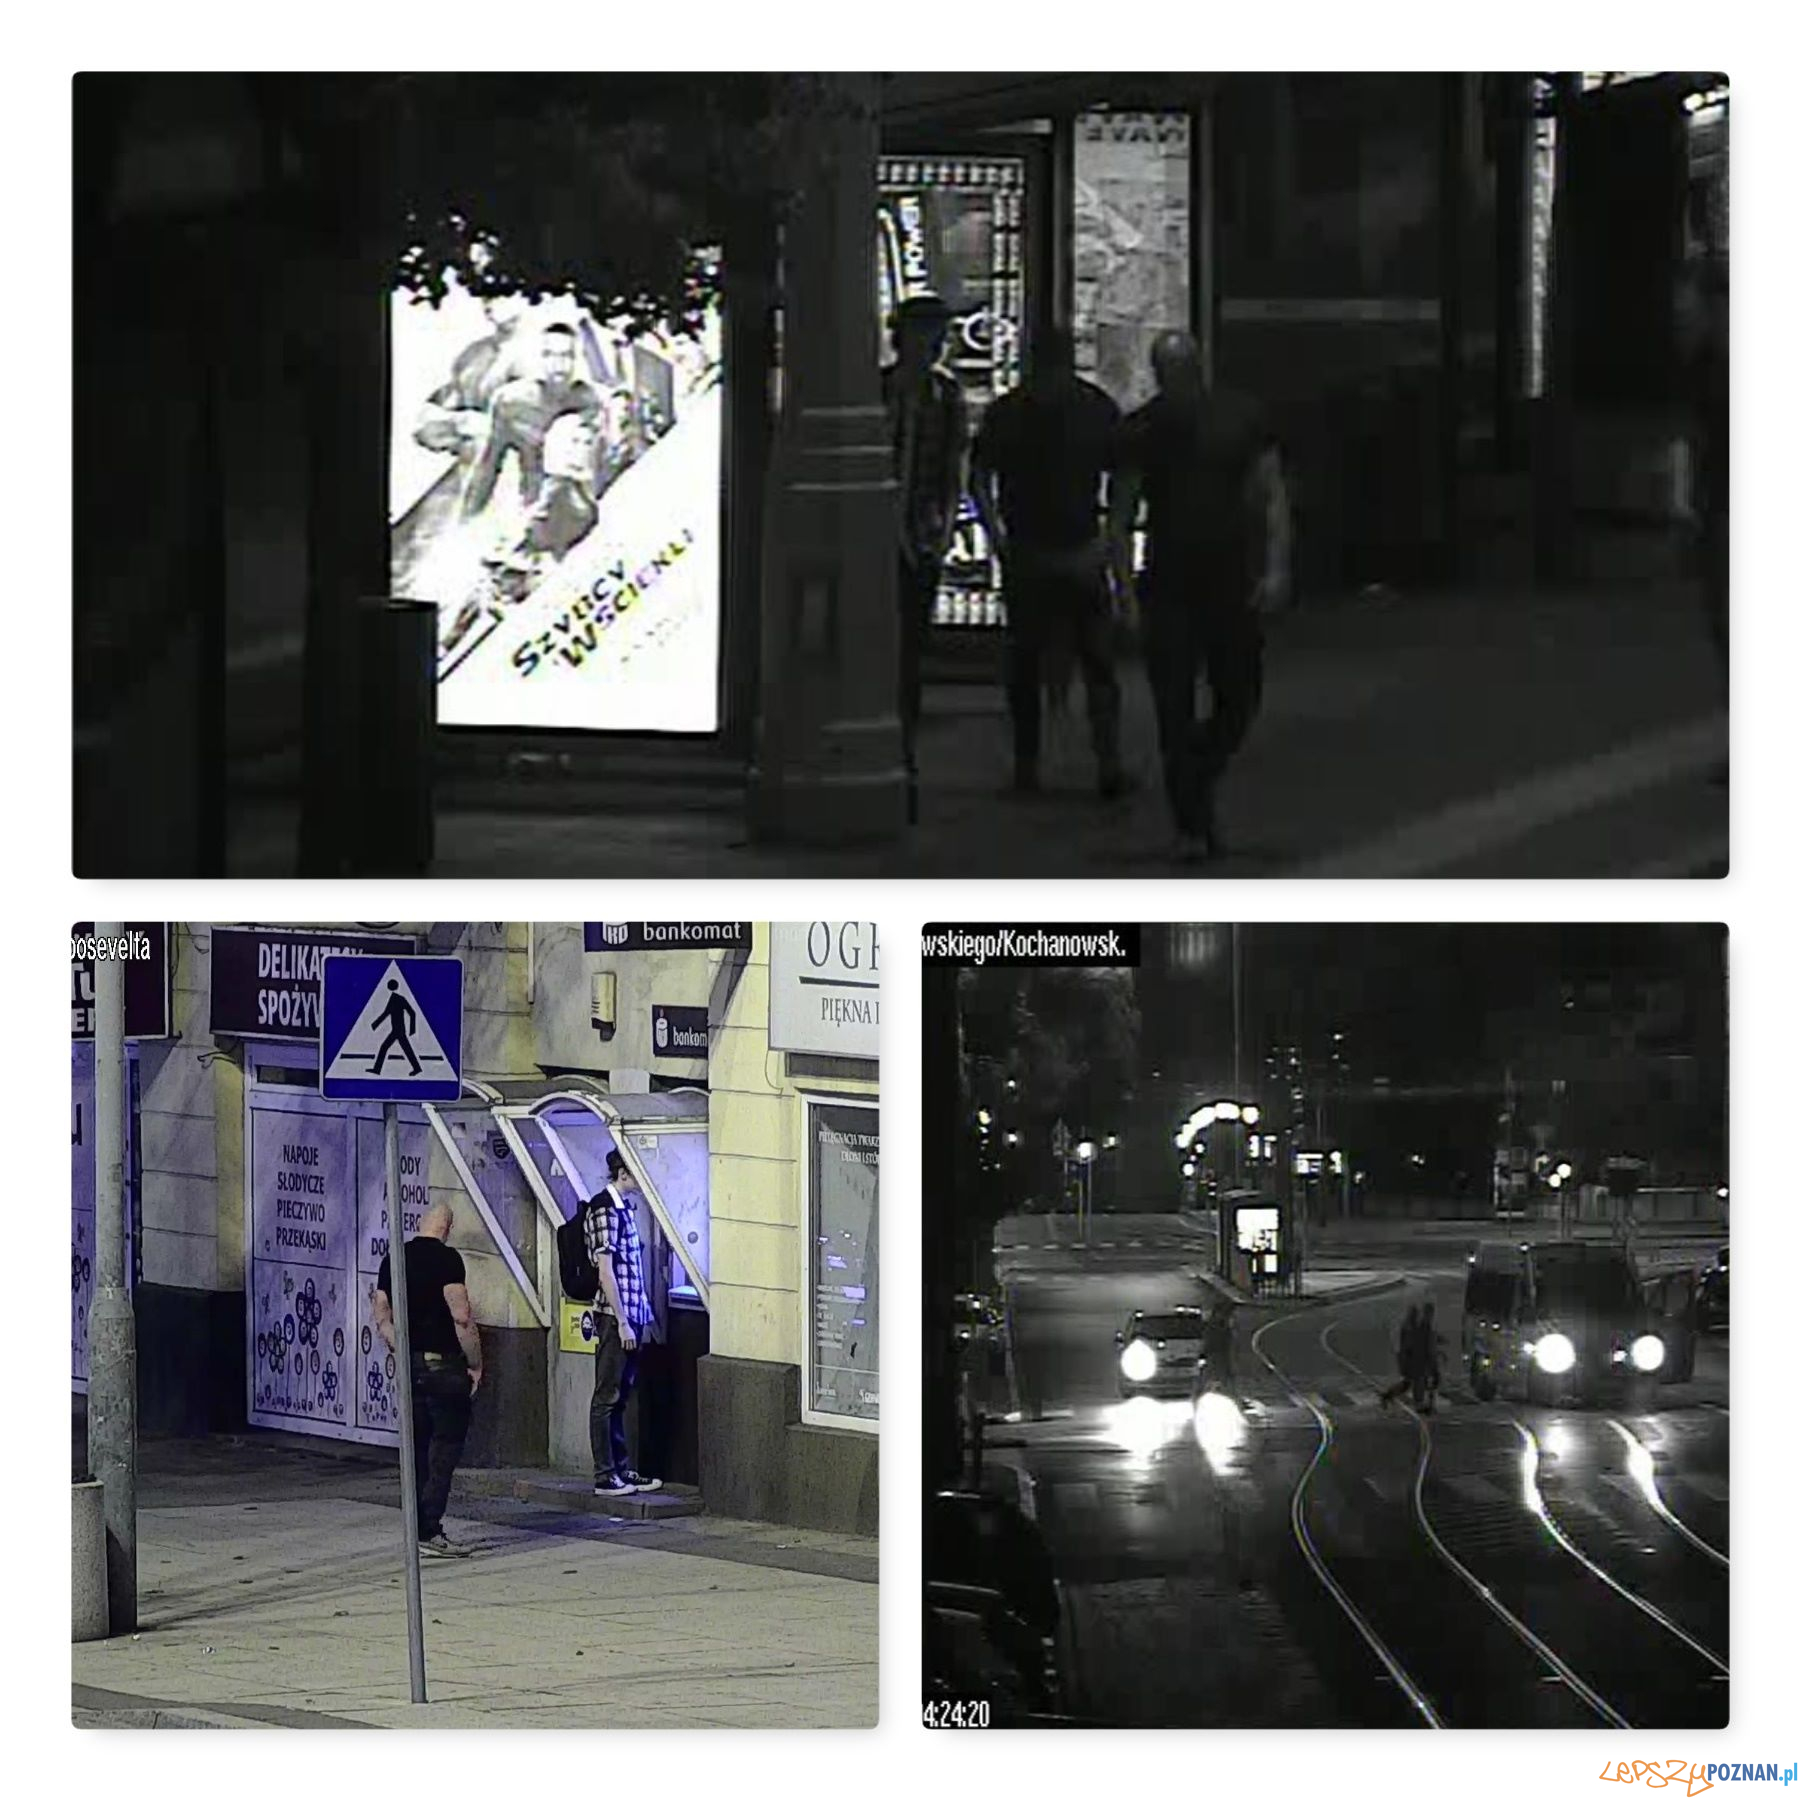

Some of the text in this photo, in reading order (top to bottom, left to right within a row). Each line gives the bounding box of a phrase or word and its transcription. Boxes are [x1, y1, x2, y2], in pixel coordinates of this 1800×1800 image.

[643, 922, 742, 941] bankomat
[258, 943, 363, 981] DELIKA
[822, 997, 872, 1027] PIĘKNA
[283, 1144, 319, 1166] NAPOJE
[400, 1155, 421, 1176] ODY
[277, 1171, 325, 1195] SŁODYCZE
[383, 1182, 429, 1205] OHOL
[277, 1199, 325, 1222] PIECZYWO
[276, 1226, 326, 1253] PRZEKĄSKI
